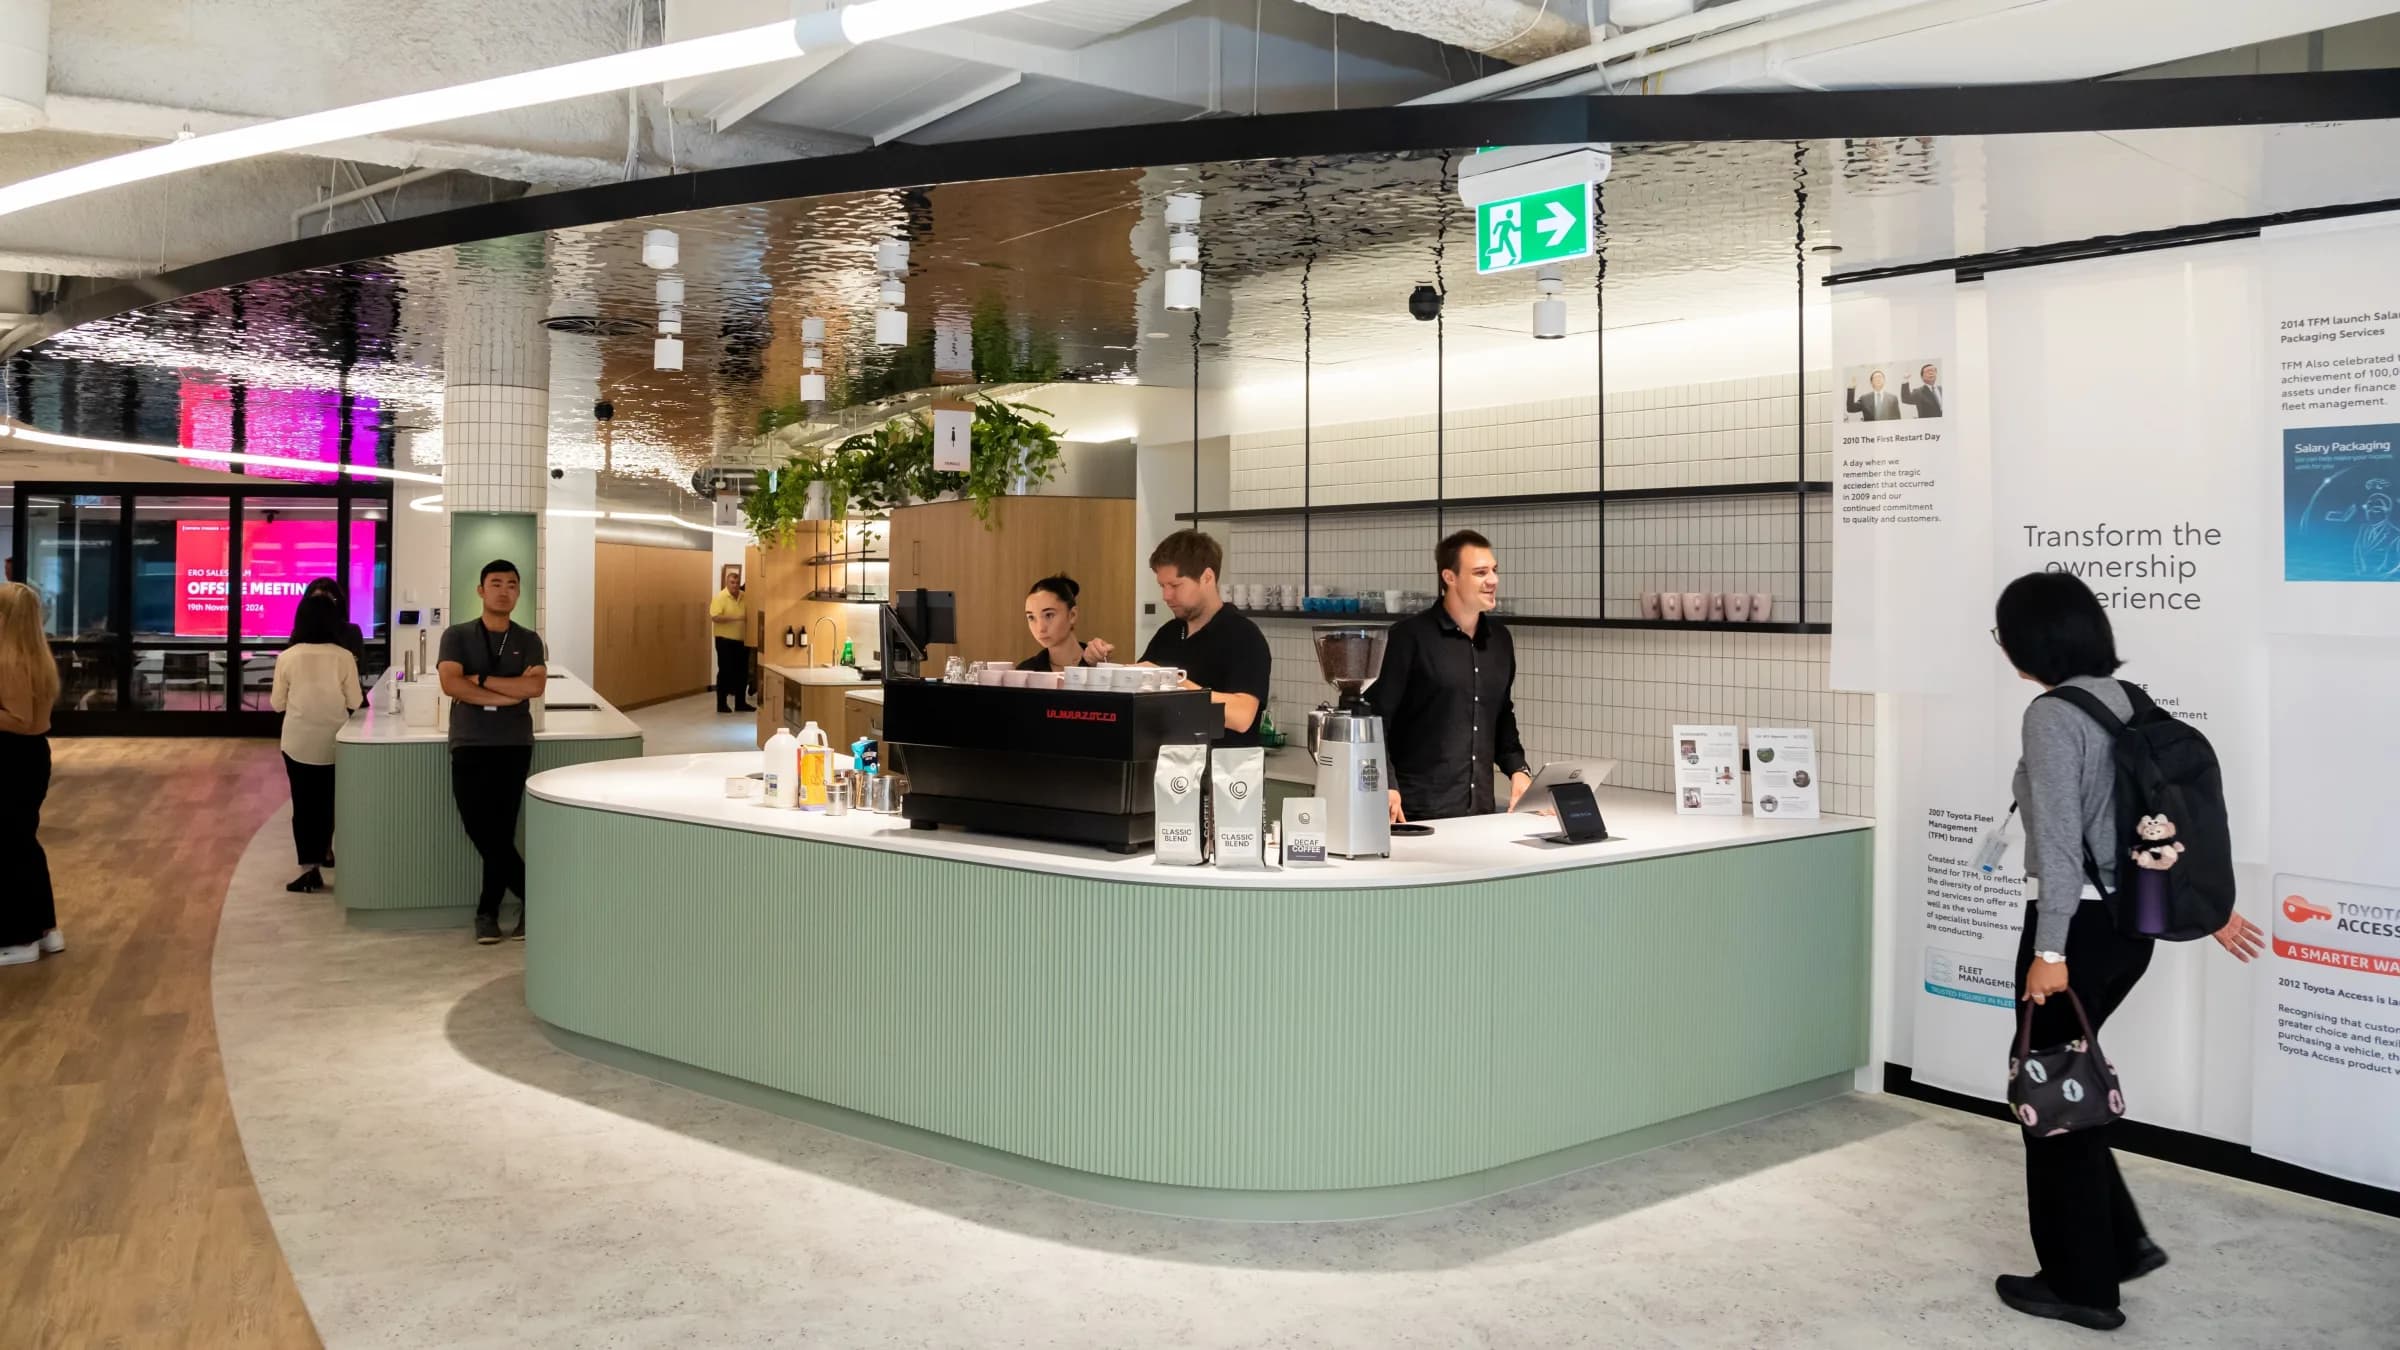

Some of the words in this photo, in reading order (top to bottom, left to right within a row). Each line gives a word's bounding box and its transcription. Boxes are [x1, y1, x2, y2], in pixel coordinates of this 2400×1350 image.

[2281, 320, 2304, 329] 2014
[2308, 317, 2329, 326] TFM
[2333, 314, 2370, 324] launch
[2281, 332, 2336, 343] Packaging
[2340, 329, 2384, 338] Services
[2281, 362, 2302, 370] TFM
[2306, 360, 2329, 368] Also
[2333, 355, 2394, 366] celebrated
[2281, 372, 2351, 384] achievement
[2354, 370, 2366, 378] of
[2369, 368, 2399, 378] 100,0
[2282, 388, 2314, 397] assets
[2318, 386, 2351, 395] under
[2354, 384, 2396, 393] finance
[2282, 403, 2306, 411] fleet
[1925, 433, 1940, 441] Day
[2295, 444, 2330, 454] Salary
[2332, 441, 2390, 453] Packaging
[1850, 460, 1862, 468] day
[1843, 470, 1882, 478] remember
[1899, 469, 1921, 477] tragic
[1851, 493, 1870, 501] 2009
[1843, 504, 1880, 512] continued
[1852, 516, 1878, 524] quality
[2024, 523, 2162, 547] Transform
[2173, 521, 2221, 546] the
[2046, 554, 2197, 584] ownership
[187, 582, 247, 594] OFFSIE
[250, 582, 307, 596] MEETIN
[2095, 586, 2200, 609] erience
[1928, 808, 1944, 817] 2007
[1946, 811, 1972, 821] Toyota
[1974, 814, 1993, 822] Fleet
[1928, 820, 1978, 832] Management
[1928, 832, 1948, 841] (TFM)
[1950, 835, 1973, 844] brand
[1928, 854, 1955, 865] Created
[1928, 865, 1948, 876] brand
[1950, 869, 1960, 877] for
[1940, 879, 1972, 892] diversity
[1984, 887, 2022, 896] products
[1941, 892, 1972, 902] services
[1986, 898, 2006, 906] offer
[1967, 908, 1997, 917] volume
[1935, 913, 1970, 925] specialist
[1972, 919, 2008, 930] business
[2288, 945, 2297, 957] A
[2301, 947, 2369, 969] SMARTER
[2373, 959, 2400, 973] WA
[1959, 965, 1983, 975] FLEET
[1959, 974, 2016, 988] MANAGEMEN
[2278, 977, 2300, 989] 2012
[2302, 981, 2335, 996] Toyota
[2338, 989, 2373, 1002] Access
[2376, 995, 2385, 1004] is
[2278, 1003, 2338, 1025] Recognising
[2340, 1017, 2361, 1028] that
[2278, 1018, 2312, 1031] greater
[2315, 1026, 2348, 1038] choice
[2351, 1033, 2371, 1043] and
[2278, 1031, 2331, 1051] purchasing
[2343, 1045, 2384, 1060] vehicle,
[2278, 1042, 2309, 1057] Toyota
[2311, 1051, 2345, 1065] Access
[2348, 1059, 2392, 1074] product
